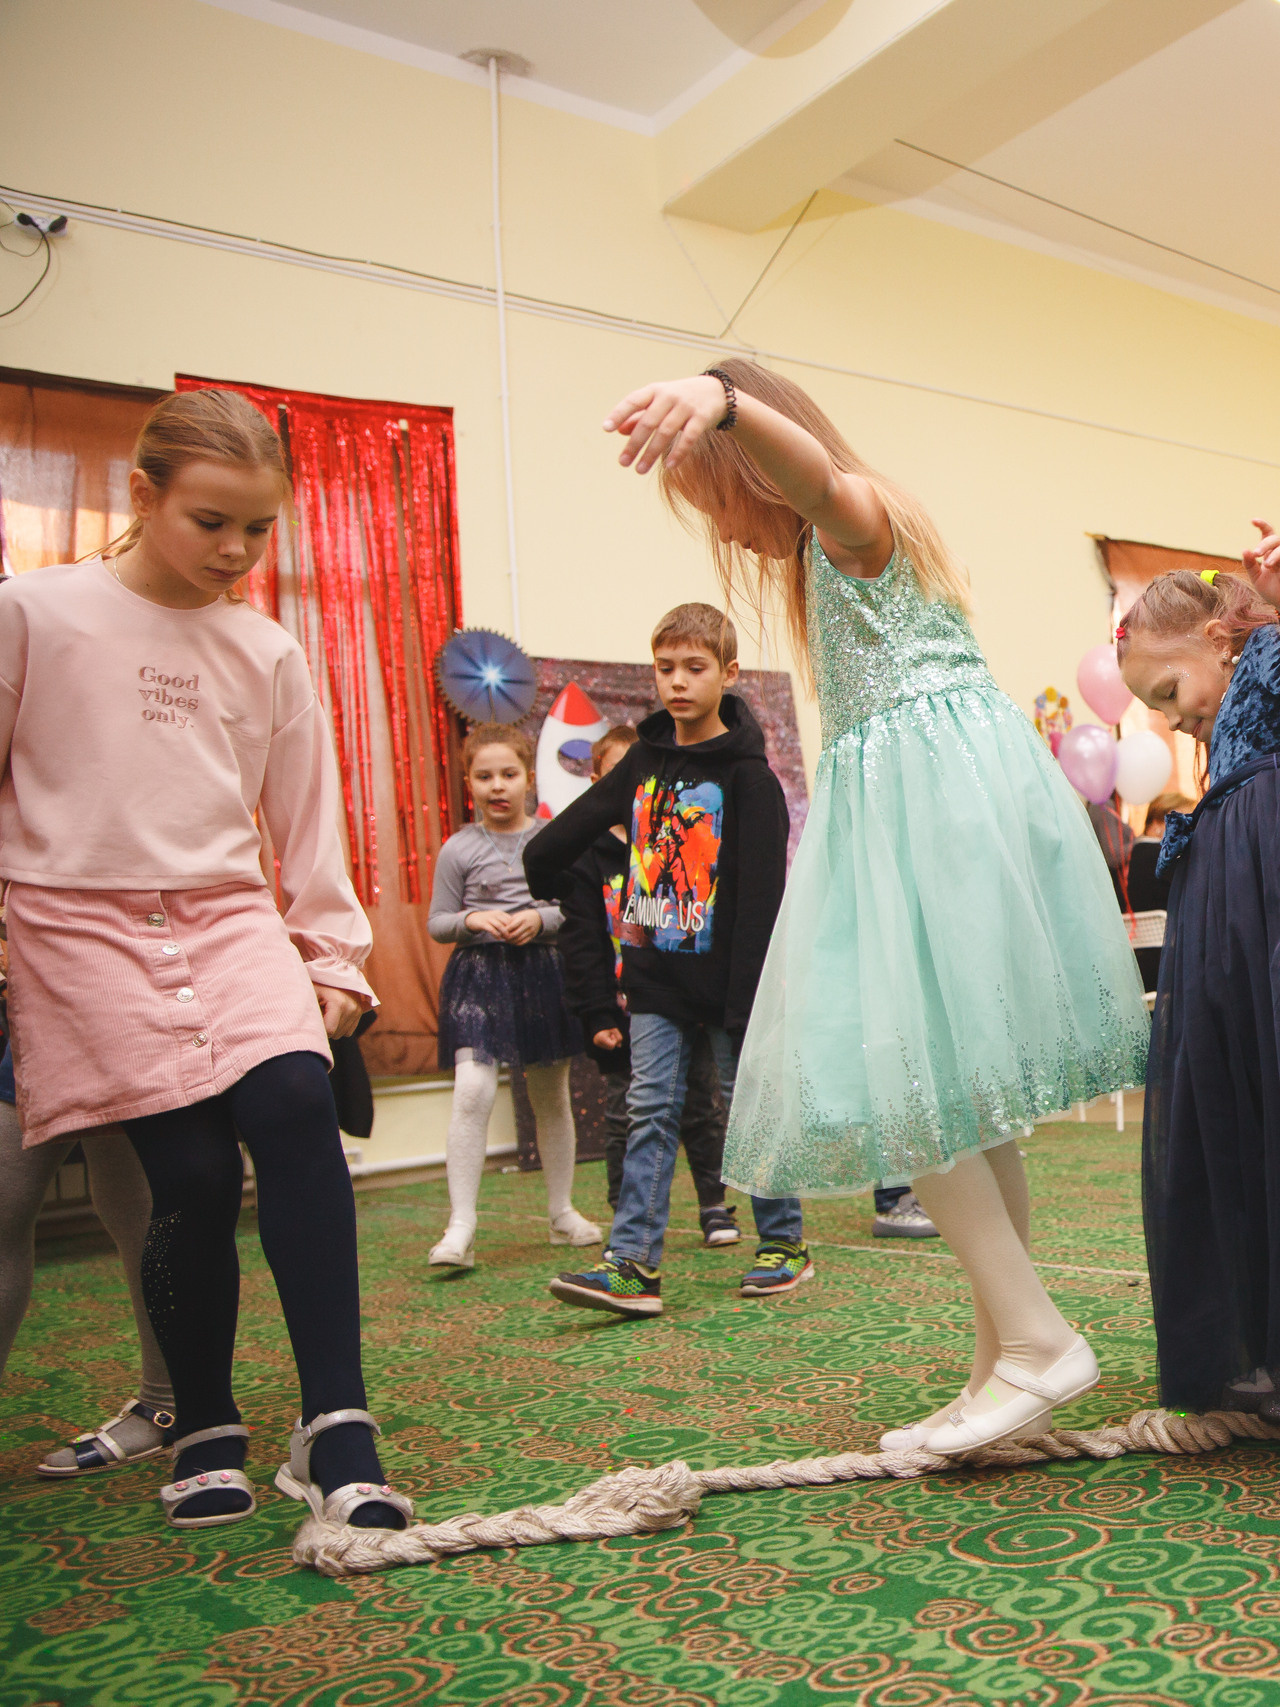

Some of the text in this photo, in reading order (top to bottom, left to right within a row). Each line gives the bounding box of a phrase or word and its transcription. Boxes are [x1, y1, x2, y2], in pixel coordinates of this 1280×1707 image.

[139, 666, 200, 692] Good
[138, 688, 199, 710] vibes
[622, 893, 705, 932] AMONG US
